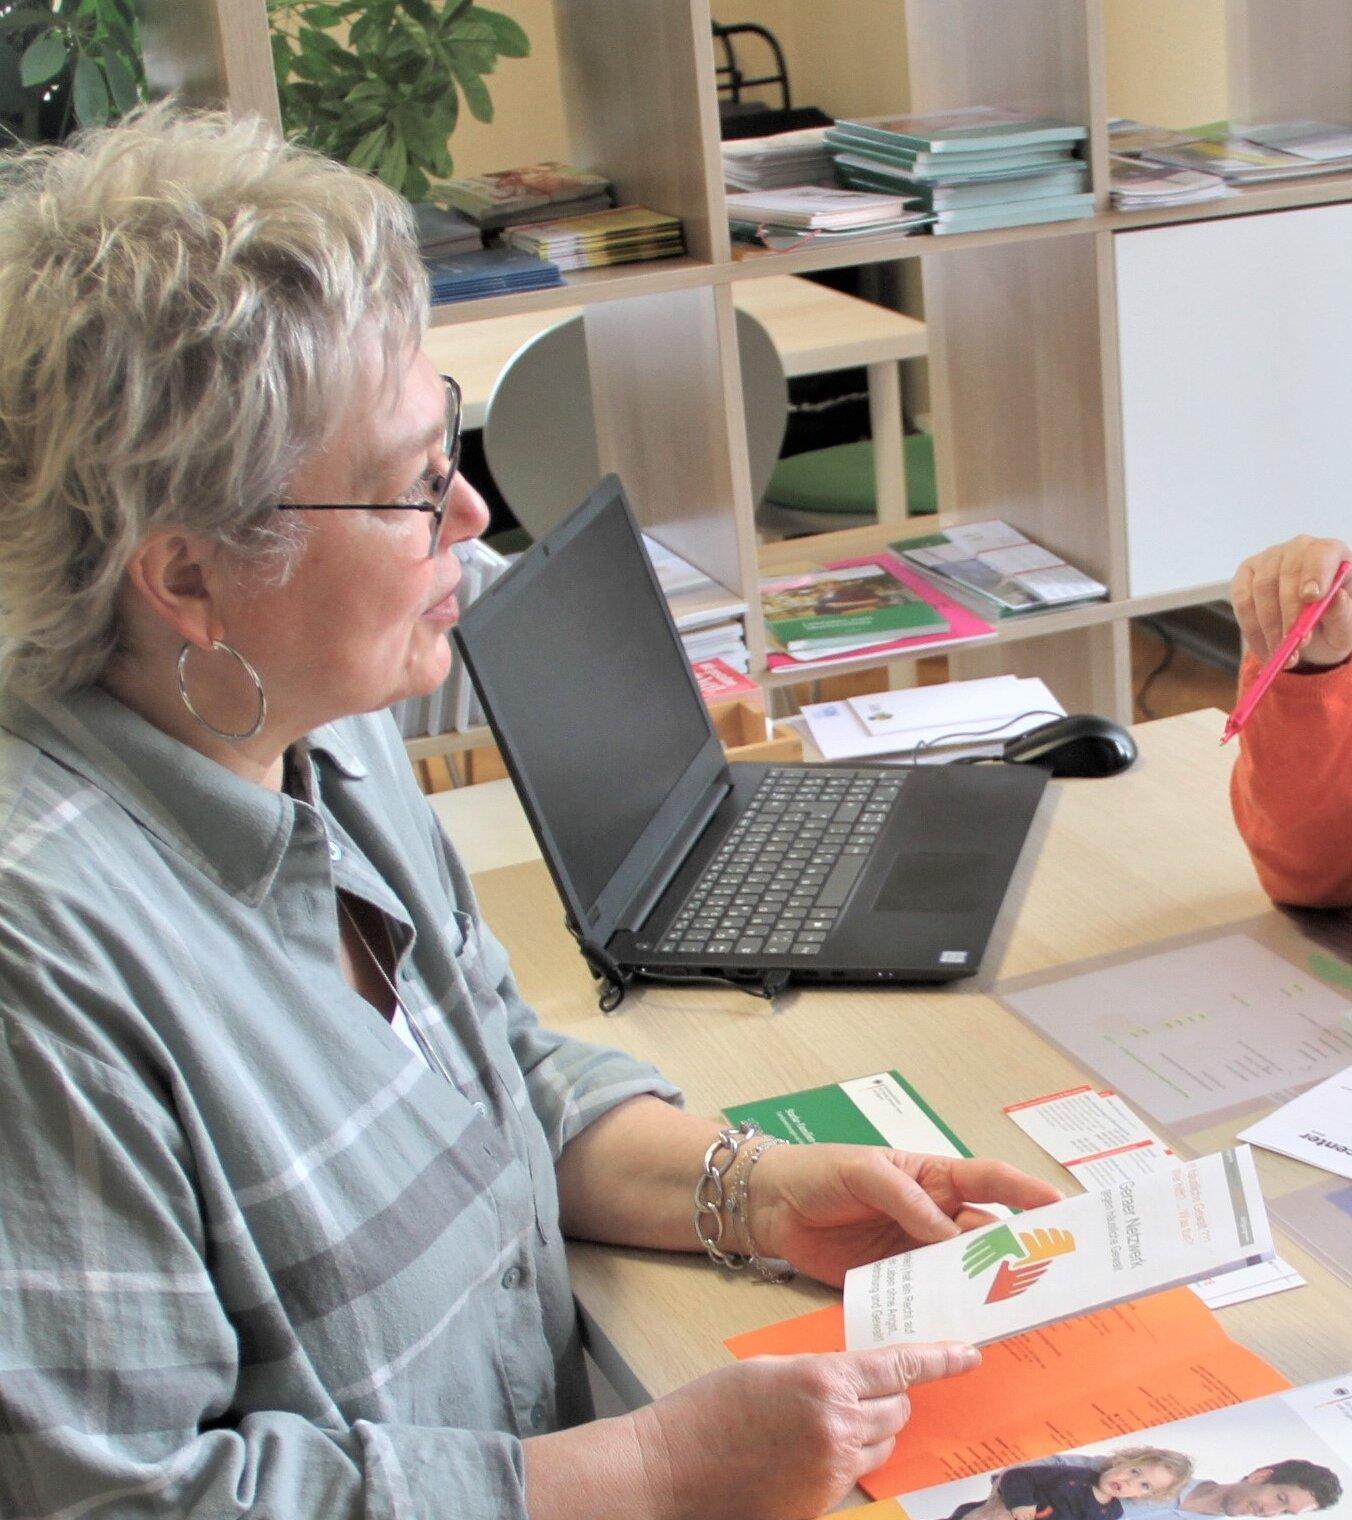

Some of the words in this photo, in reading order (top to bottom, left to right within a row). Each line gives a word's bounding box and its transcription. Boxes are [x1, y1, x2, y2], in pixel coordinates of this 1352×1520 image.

[1119, 1180, 1136, 1216] Geraer
[1125, 1217, 1145, 1269] Netzwerk
[902, 1295, 914, 1319] Recht
